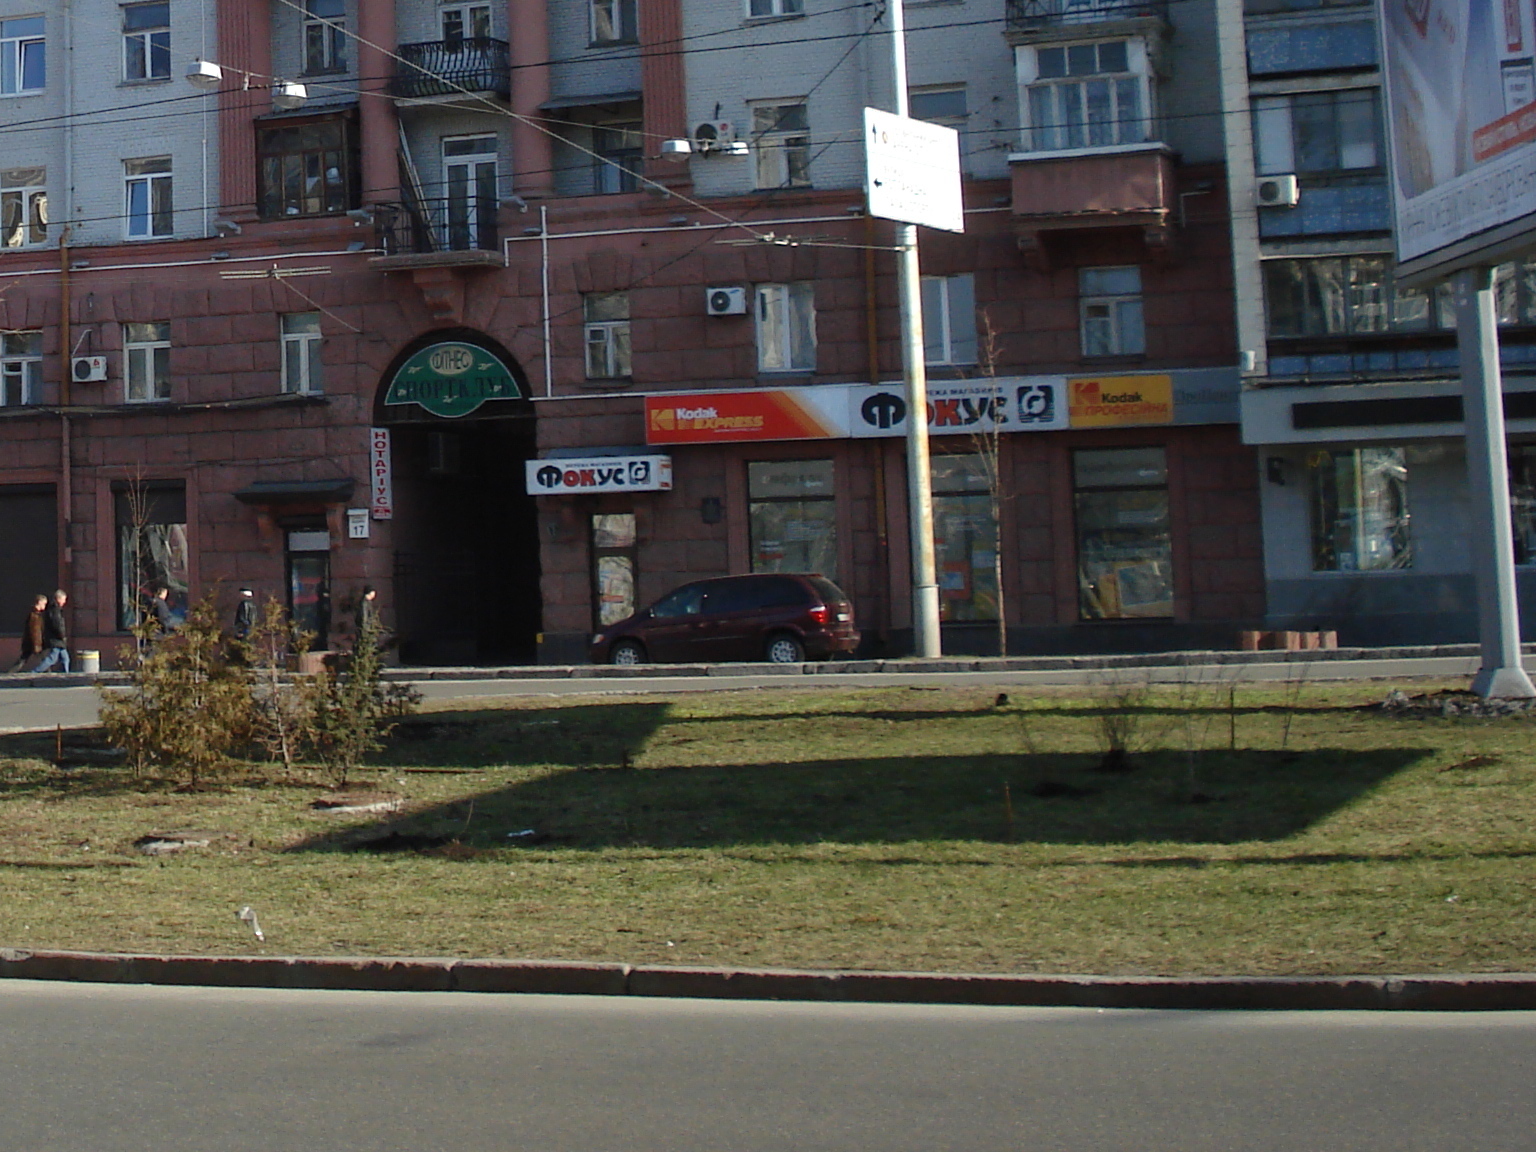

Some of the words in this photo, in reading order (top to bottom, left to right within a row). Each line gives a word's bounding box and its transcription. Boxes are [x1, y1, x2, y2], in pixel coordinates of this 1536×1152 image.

[1102, 392, 1143, 403] Kodak
[676, 407, 717, 420] Kodak
[861, 392, 1009, 429] ФКУС
[693, 416, 764, 430] EXPRESS
[374, 431, 388, 505] НОТАРІУС
[354, 525, 365, 536] 17
